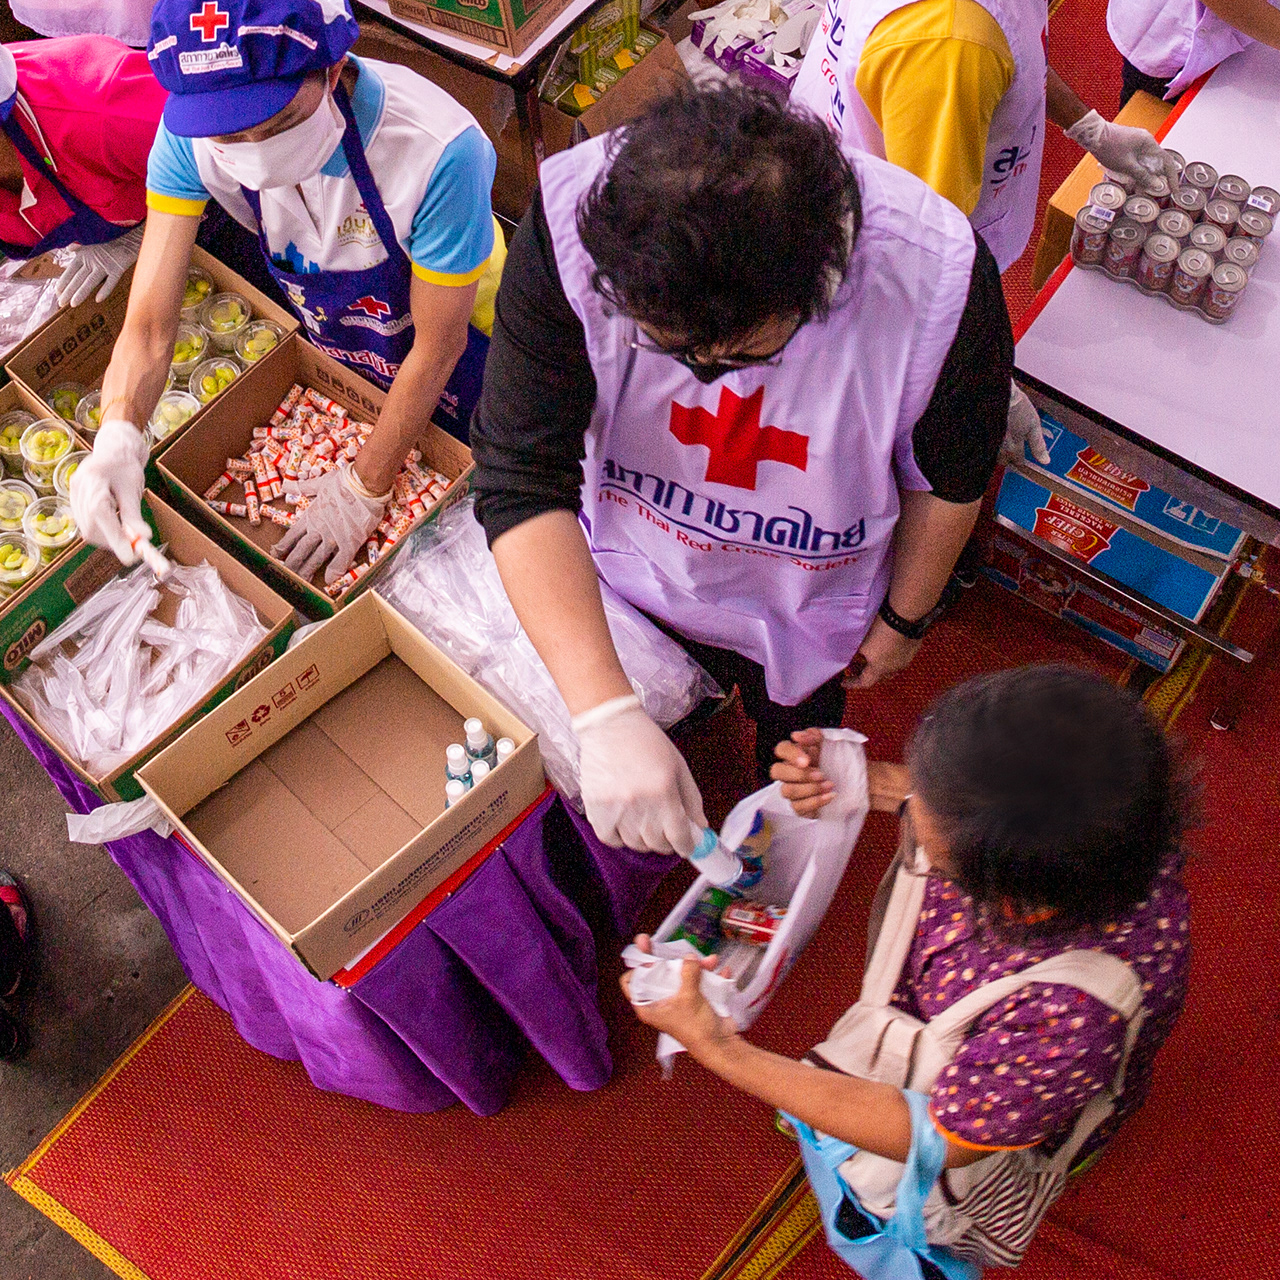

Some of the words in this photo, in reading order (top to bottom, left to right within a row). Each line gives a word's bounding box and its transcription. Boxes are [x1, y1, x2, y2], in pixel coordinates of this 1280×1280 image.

[635, 501, 671, 534] Thai
[676, 529, 713, 553] Red
[1044, 512, 1087, 540] CHEF
[1058, 504, 1104, 531] MACKEREL
[1077, 508, 1103, 524] TOMATO
[1050, 529, 1075, 545] SUPER
[7, 622, 45, 665] MILO
